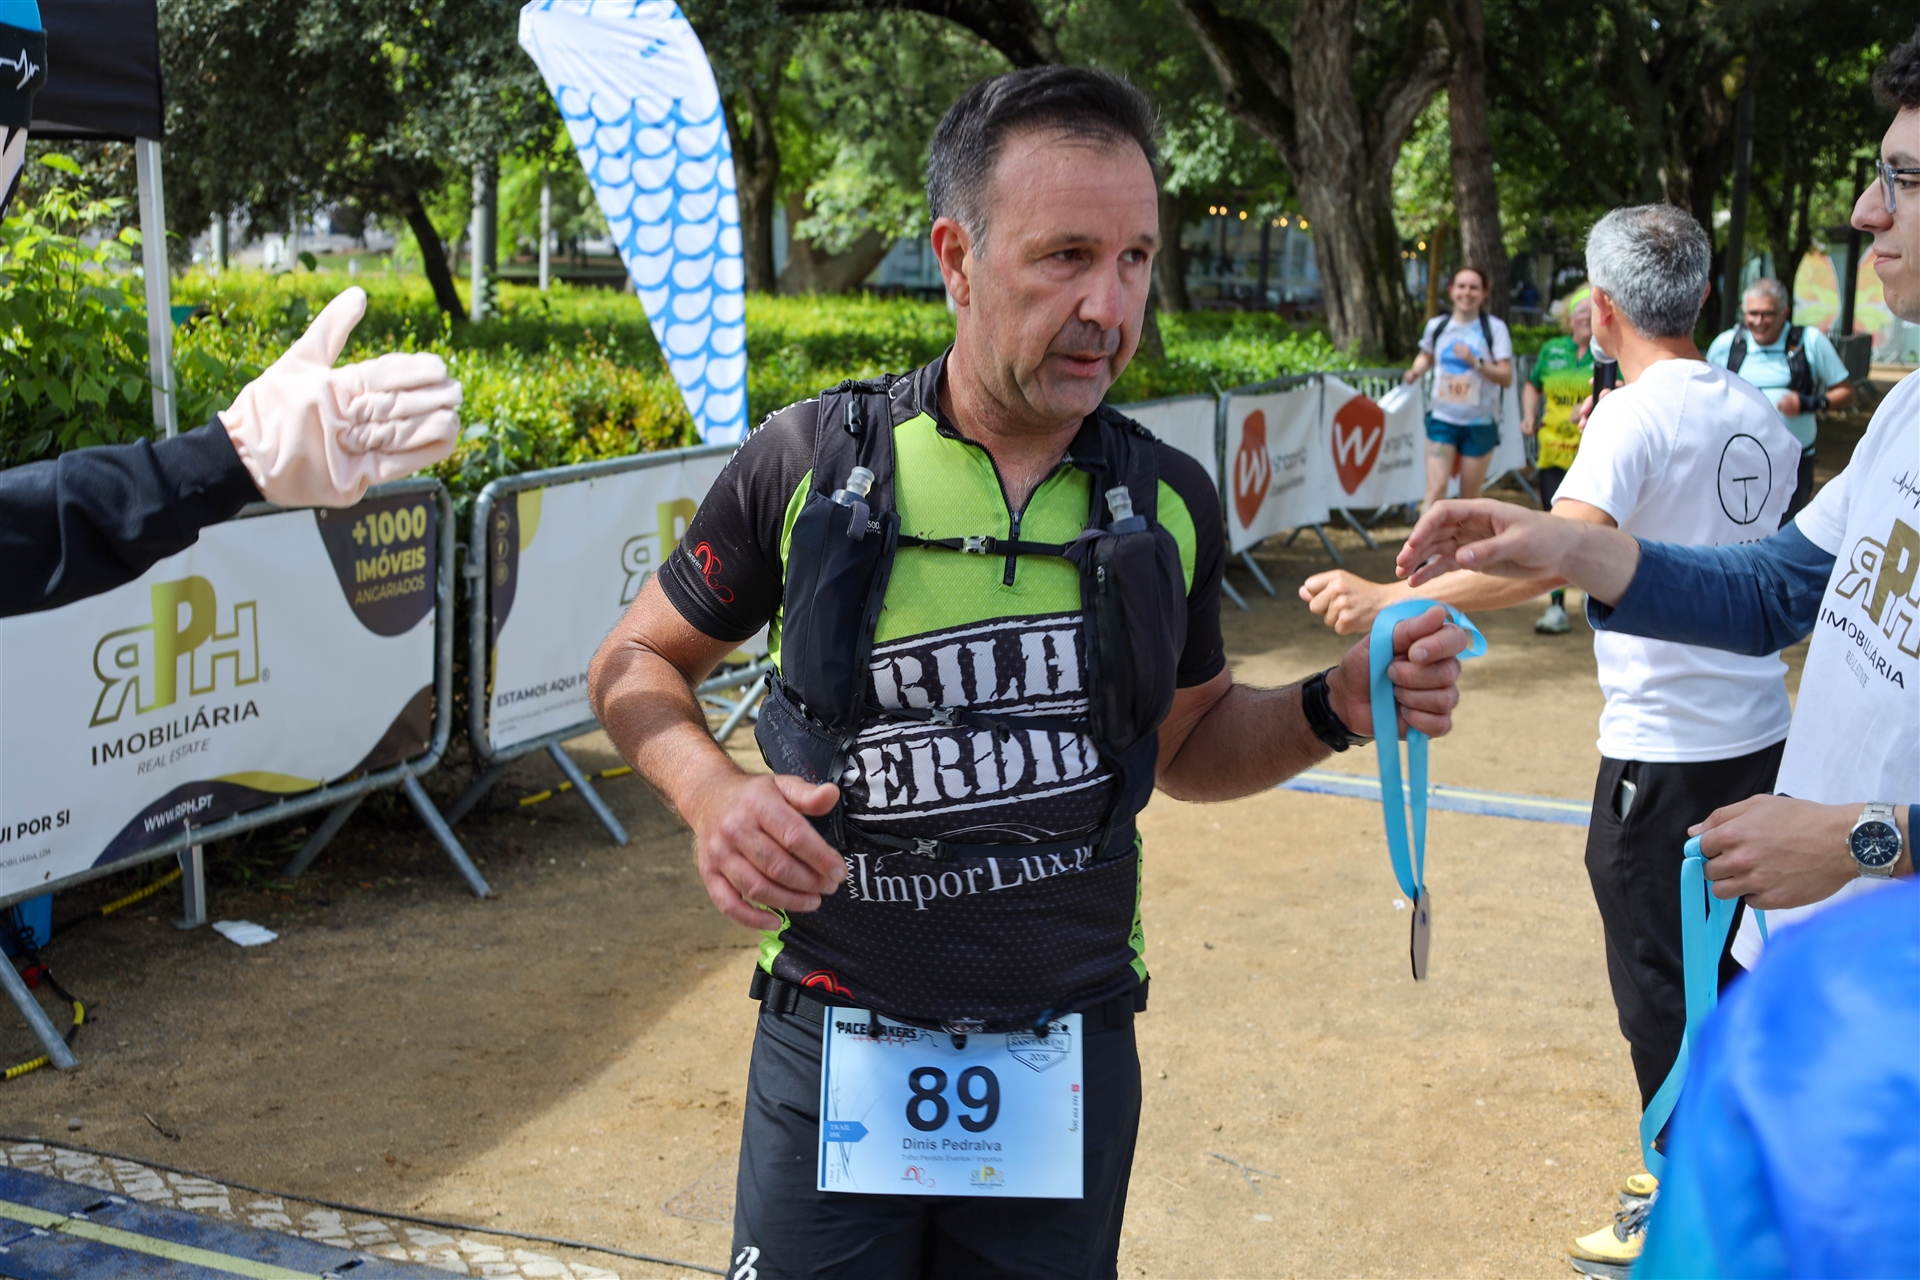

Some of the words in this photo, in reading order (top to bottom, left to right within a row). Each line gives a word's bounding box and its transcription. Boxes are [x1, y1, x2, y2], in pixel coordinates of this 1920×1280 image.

[352, 504, 427, 548] +1000
[355, 545, 427, 583] IMÓVEIS
[354, 574, 426, 606] ANGARIADOS
[1820, 607, 1905, 690] IMOBILIÁRIA
[497, 682, 548, 707] ESTAMOS
[550, 675, 577, 693] AQUI
[92, 699, 259, 767] IMOBILIÁRIA
[136, 756, 167, 776] REAL
[169, 738, 211, 764] ESTATE
[17, 816, 52, 840] POR
[56, 809, 70, 828] SI
[143, 794, 214, 833] WWW.RPH.PT
[905, 1065, 1000, 1133] 89
[902, 1137, 938, 1150] Dinis
[942, 1138, 1003, 1152] Pedralva
